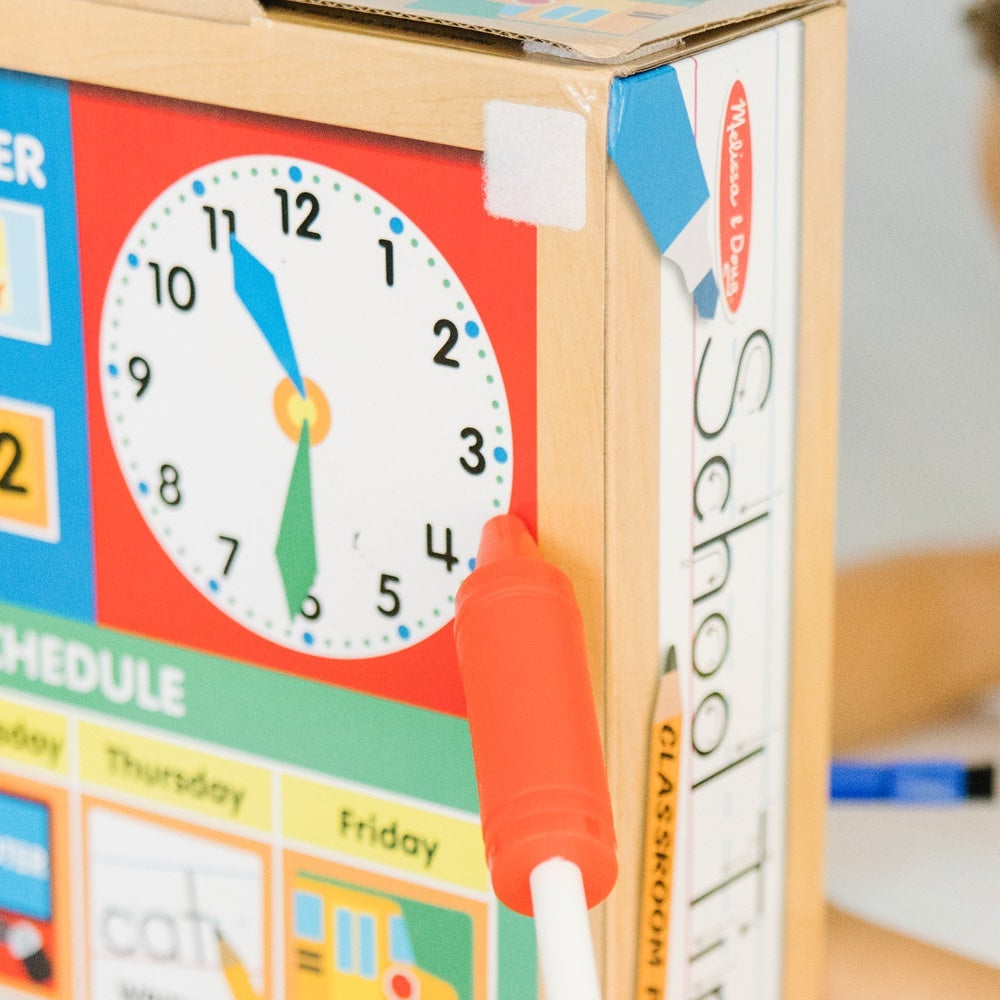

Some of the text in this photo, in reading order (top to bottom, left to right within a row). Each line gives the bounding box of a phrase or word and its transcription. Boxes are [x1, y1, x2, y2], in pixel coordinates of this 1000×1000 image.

[726, 97, 747, 207] Melissa
[202, 205, 237, 251] 11
[275, 187, 322, 241] 12
[148, 261, 196, 312] 10
[379, 239, 395, 287] 1
[723, 234, 745, 297] Doug
[433, 318, 461, 369] 2
[128, 356, 151, 399] 9
[459, 426, 486, 475] 3
[158, 464, 181, 506] 8
[217, 535, 240, 576] 7
[425, 522, 459, 572] 4
[692, 329, 773, 791] School
[376, 574, 401, 617] 5
[104, 745, 247, 819] Thursday
[338, 810, 441, 868] Friday
[649, 725, 676, 967] CLASSROOM
